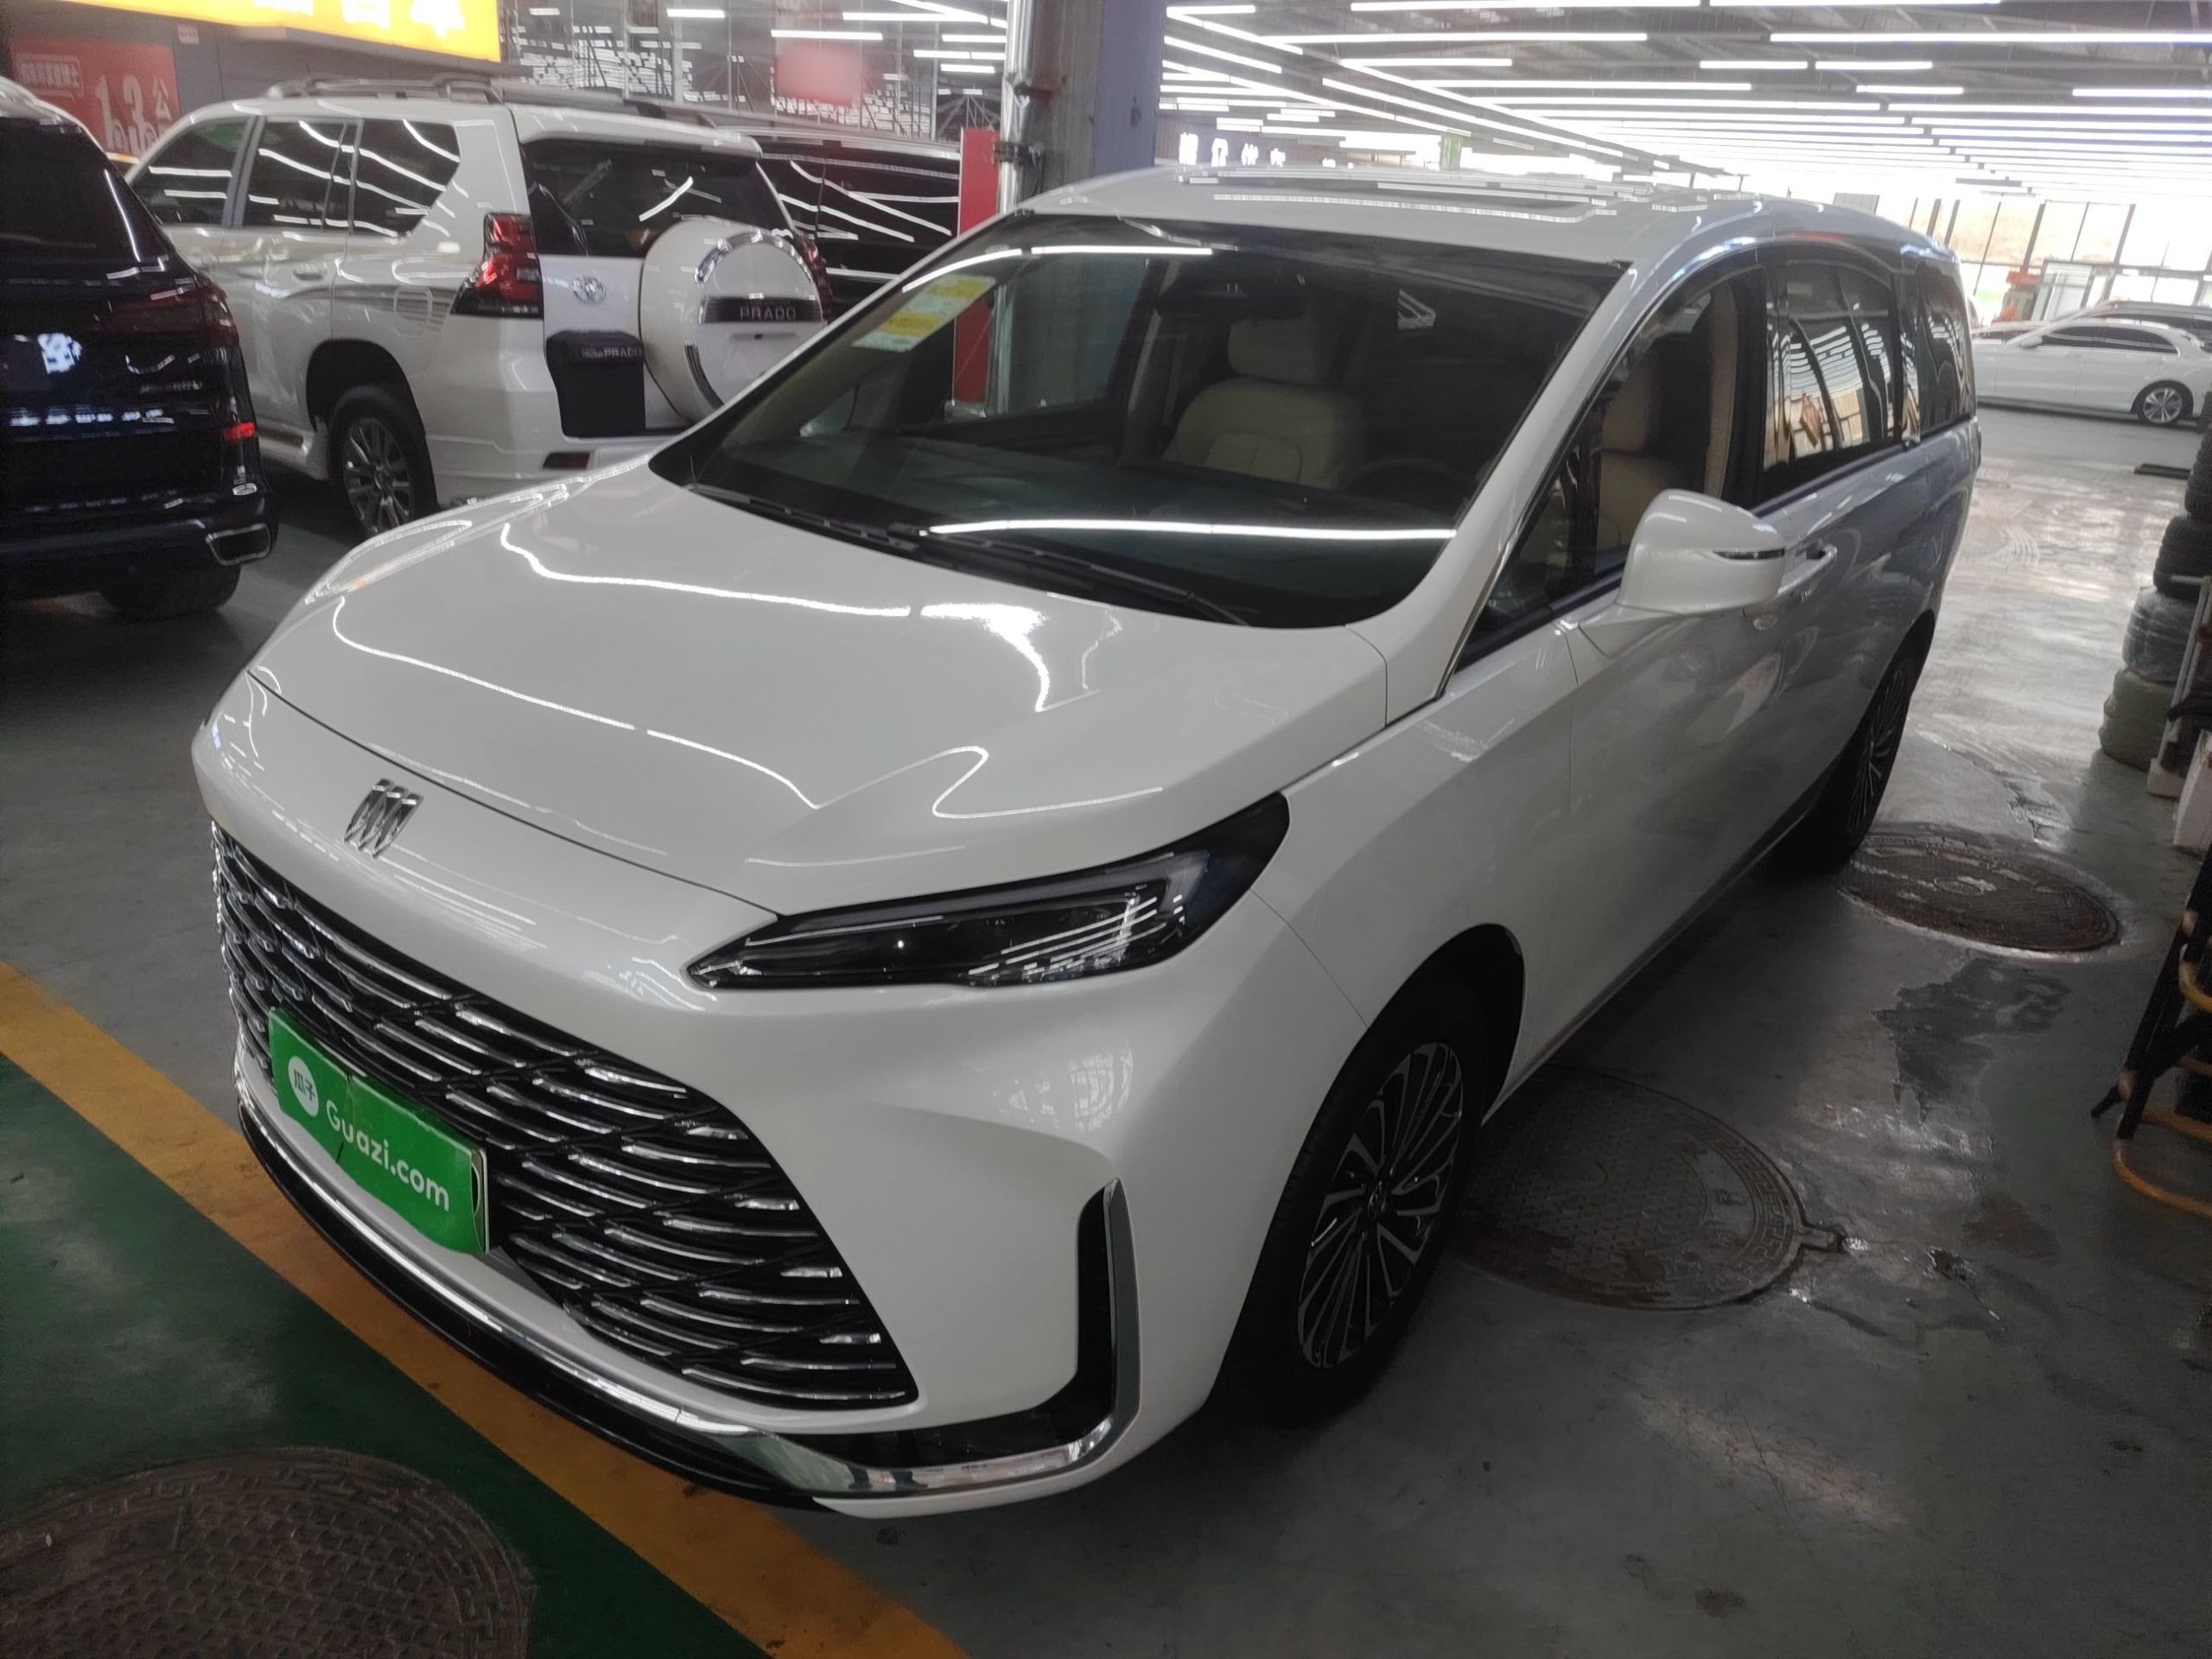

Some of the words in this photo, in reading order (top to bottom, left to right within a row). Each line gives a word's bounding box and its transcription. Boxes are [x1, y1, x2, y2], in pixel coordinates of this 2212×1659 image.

[739, 306, 797, 321] PRADO
[294, 1068, 316, 1102] 瓜子
[326, 1099, 449, 1212] Guazi.com
